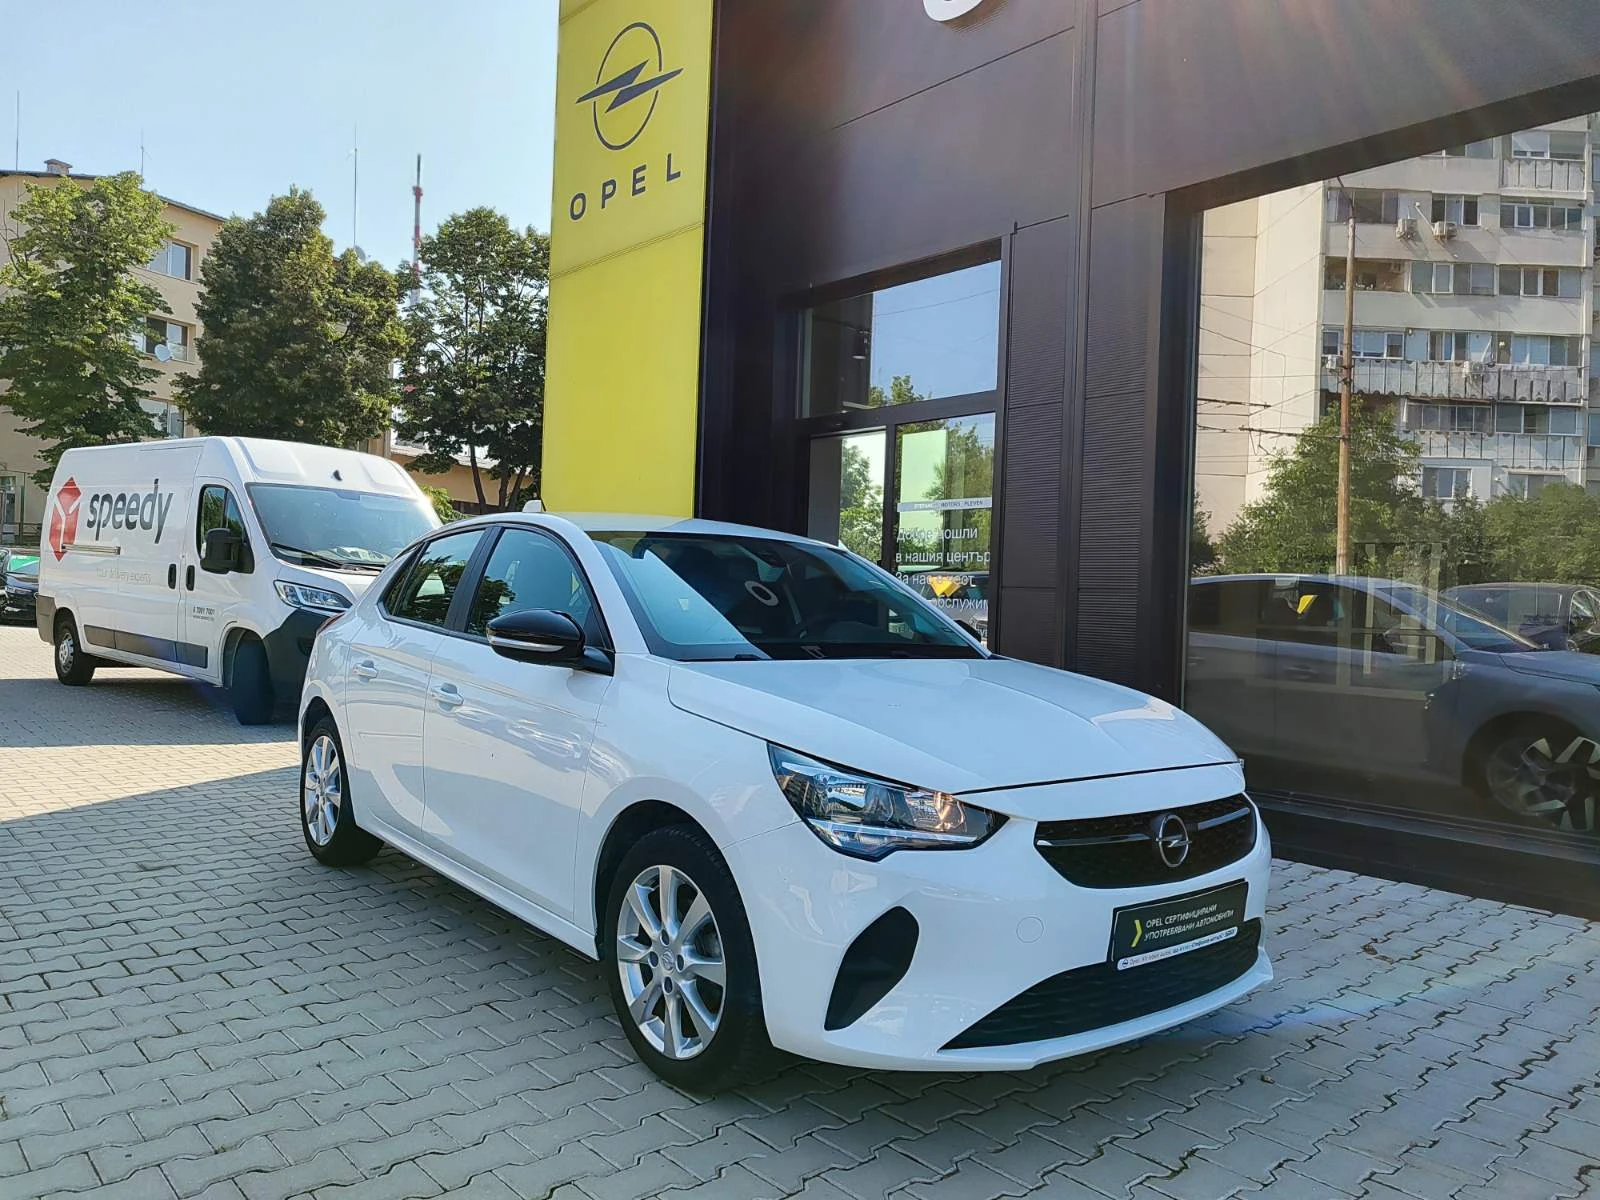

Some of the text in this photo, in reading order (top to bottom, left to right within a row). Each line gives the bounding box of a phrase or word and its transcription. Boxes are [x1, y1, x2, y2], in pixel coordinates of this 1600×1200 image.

[569, 153, 682, 221] OPEL
[86, 478, 174, 544] speedy
[895, 551, 991, 566] в нашия център
[912, 573, 931, 585] нас
[1143, 909, 1234, 941] УПОТРЕБЯВАНИ АВТОМОБИЛИ
[1145, 903, 1218, 929] OPEL СЕРТИФИЦИРАНИ
